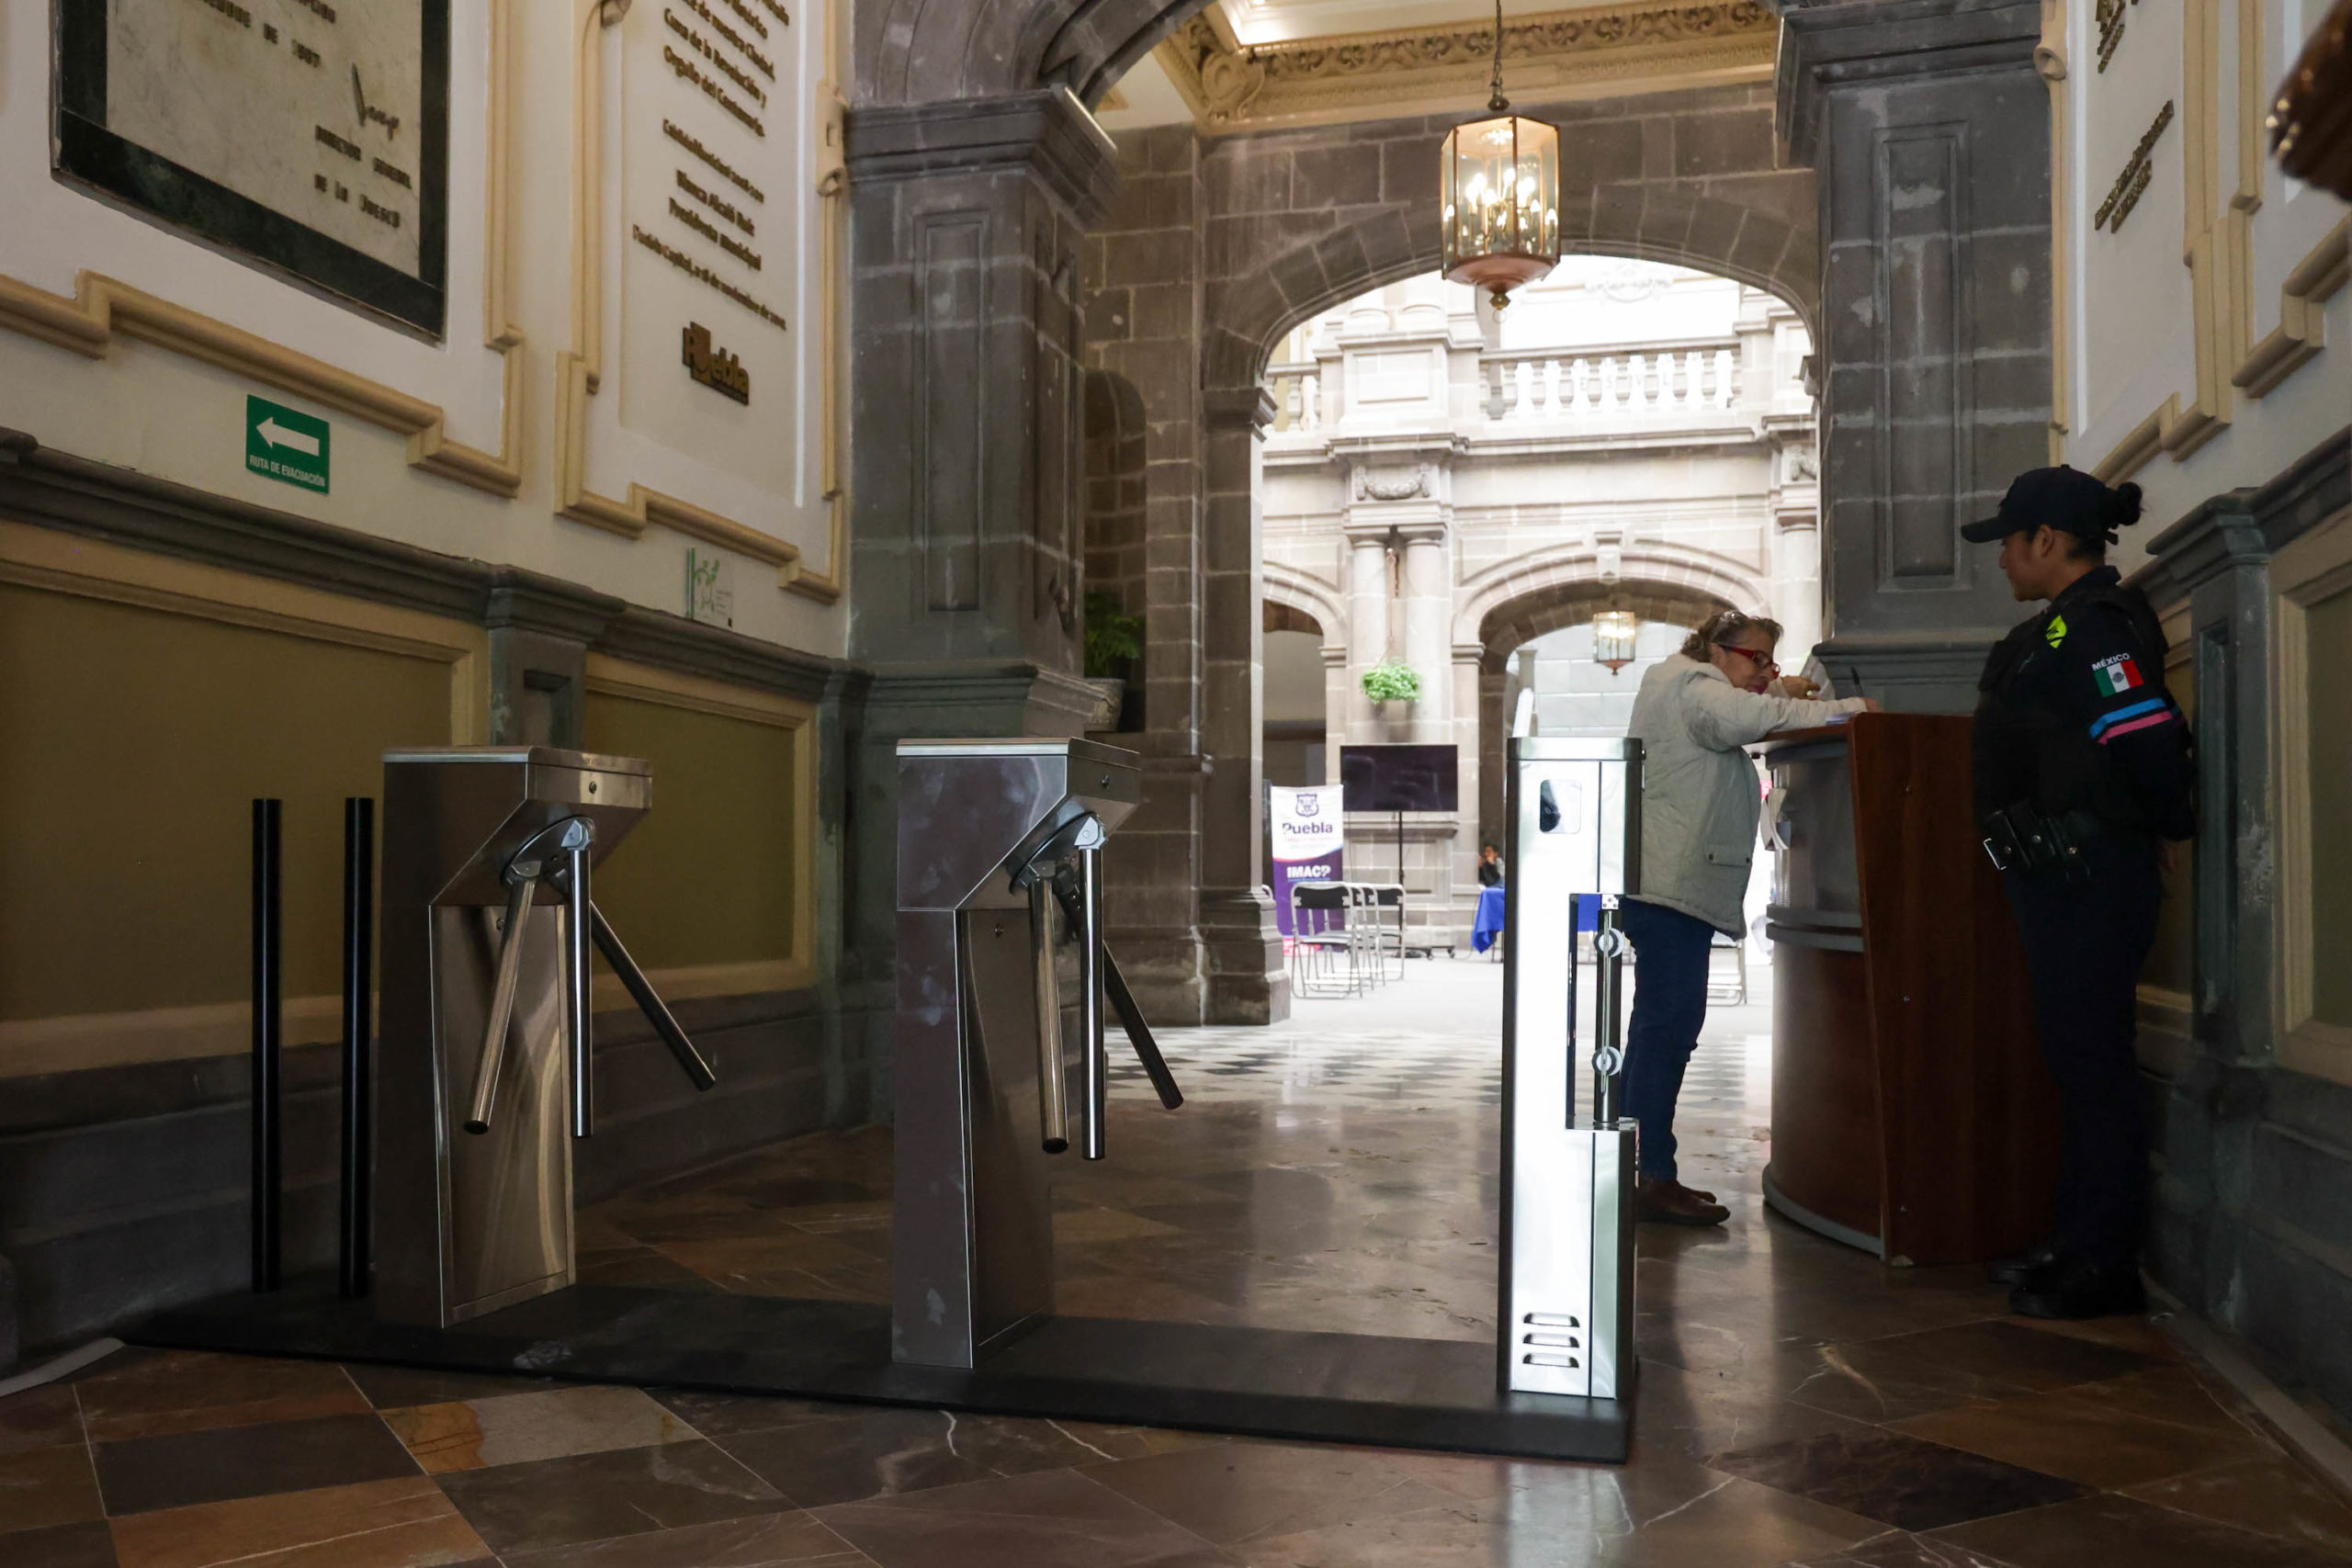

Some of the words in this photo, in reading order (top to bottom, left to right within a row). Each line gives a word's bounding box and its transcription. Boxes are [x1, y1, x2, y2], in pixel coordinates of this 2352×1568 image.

[249, 455, 268, 470] RUTA
[270, 461, 280, 474] DE
[2091, 652, 2131, 671] MÉXICO
[1282, 821, 1334, 835] Puebla
